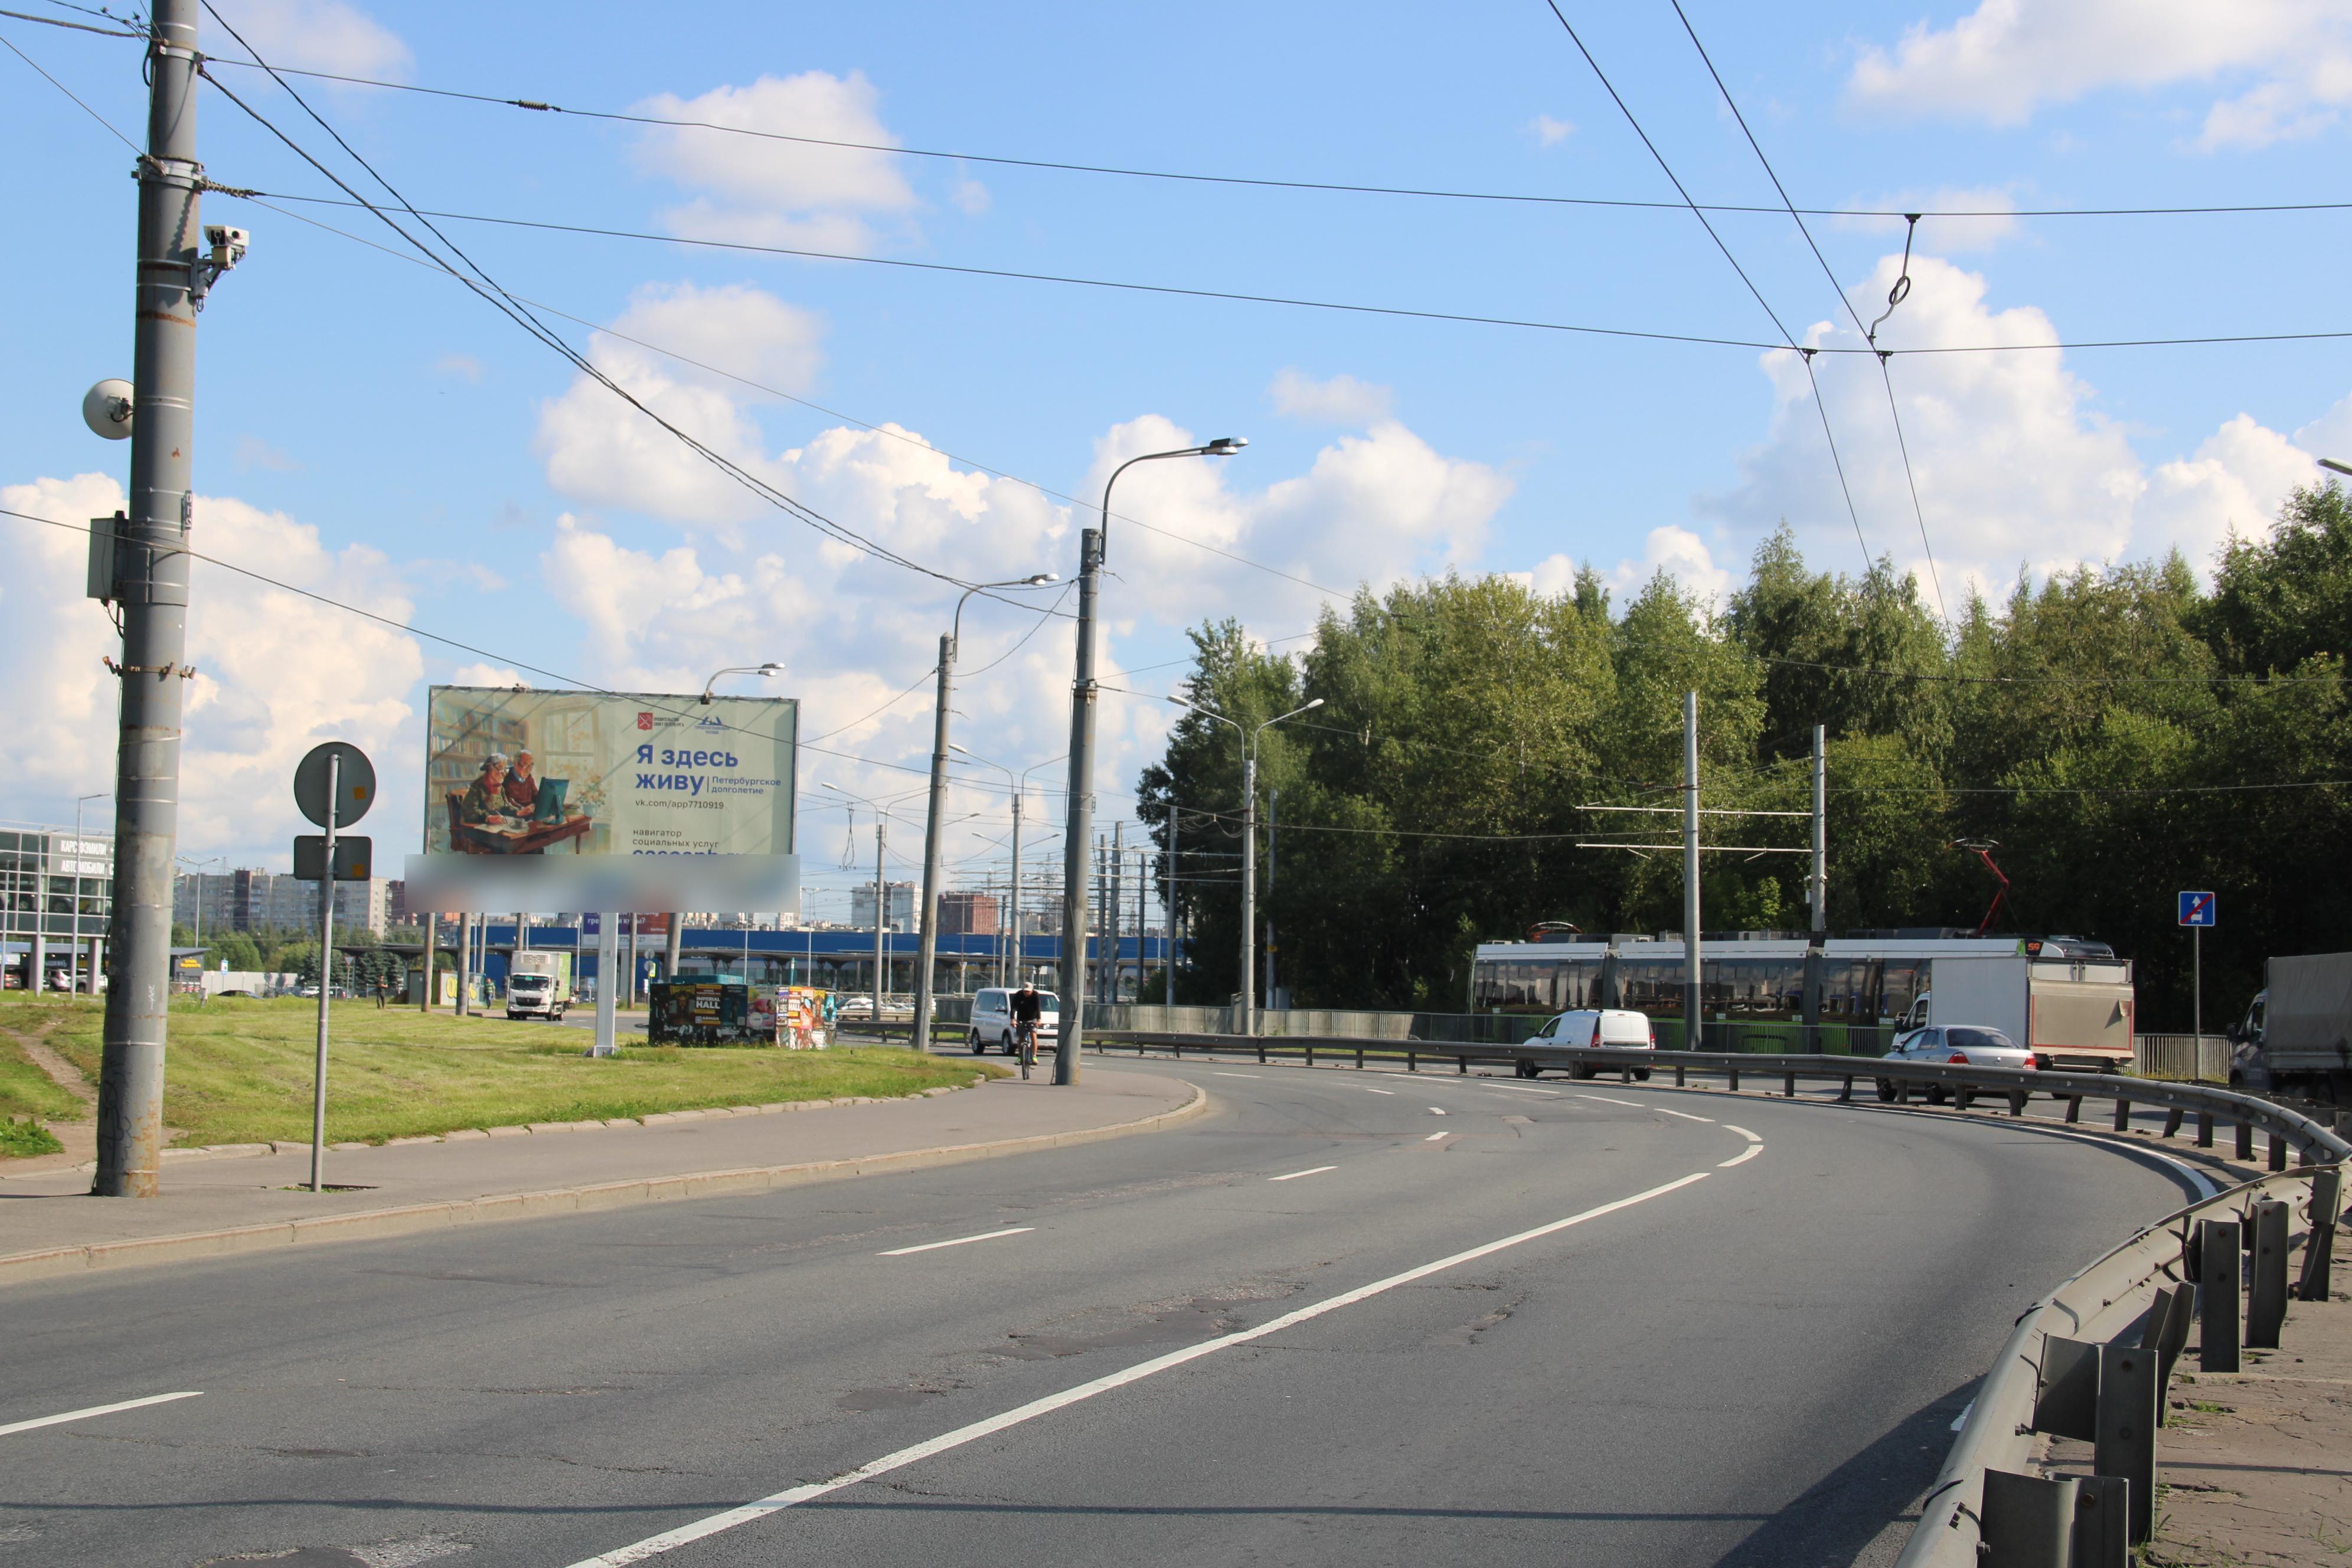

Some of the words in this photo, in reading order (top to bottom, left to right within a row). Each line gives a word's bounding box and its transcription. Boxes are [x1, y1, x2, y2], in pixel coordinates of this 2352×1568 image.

[637, 744, 654, 765] Я
[661, 749, 738, 769] здесь
[635, 773, 705, 796] живу
[712, 776, 781, 787] Петербургское
[711, 786, 764, 795] долголетие
[635, 798, 724, 809] vk.com/app7710919
[633, 829, 682, 838] навигатор
[61, 840, 78, 853] КАРС
[632, 838, 690, 847] социальных
[693, 839, 720, 849] услуг
[2027, 942, 2041, 950] 59
[696, 1001, 720, 1010] HALL
